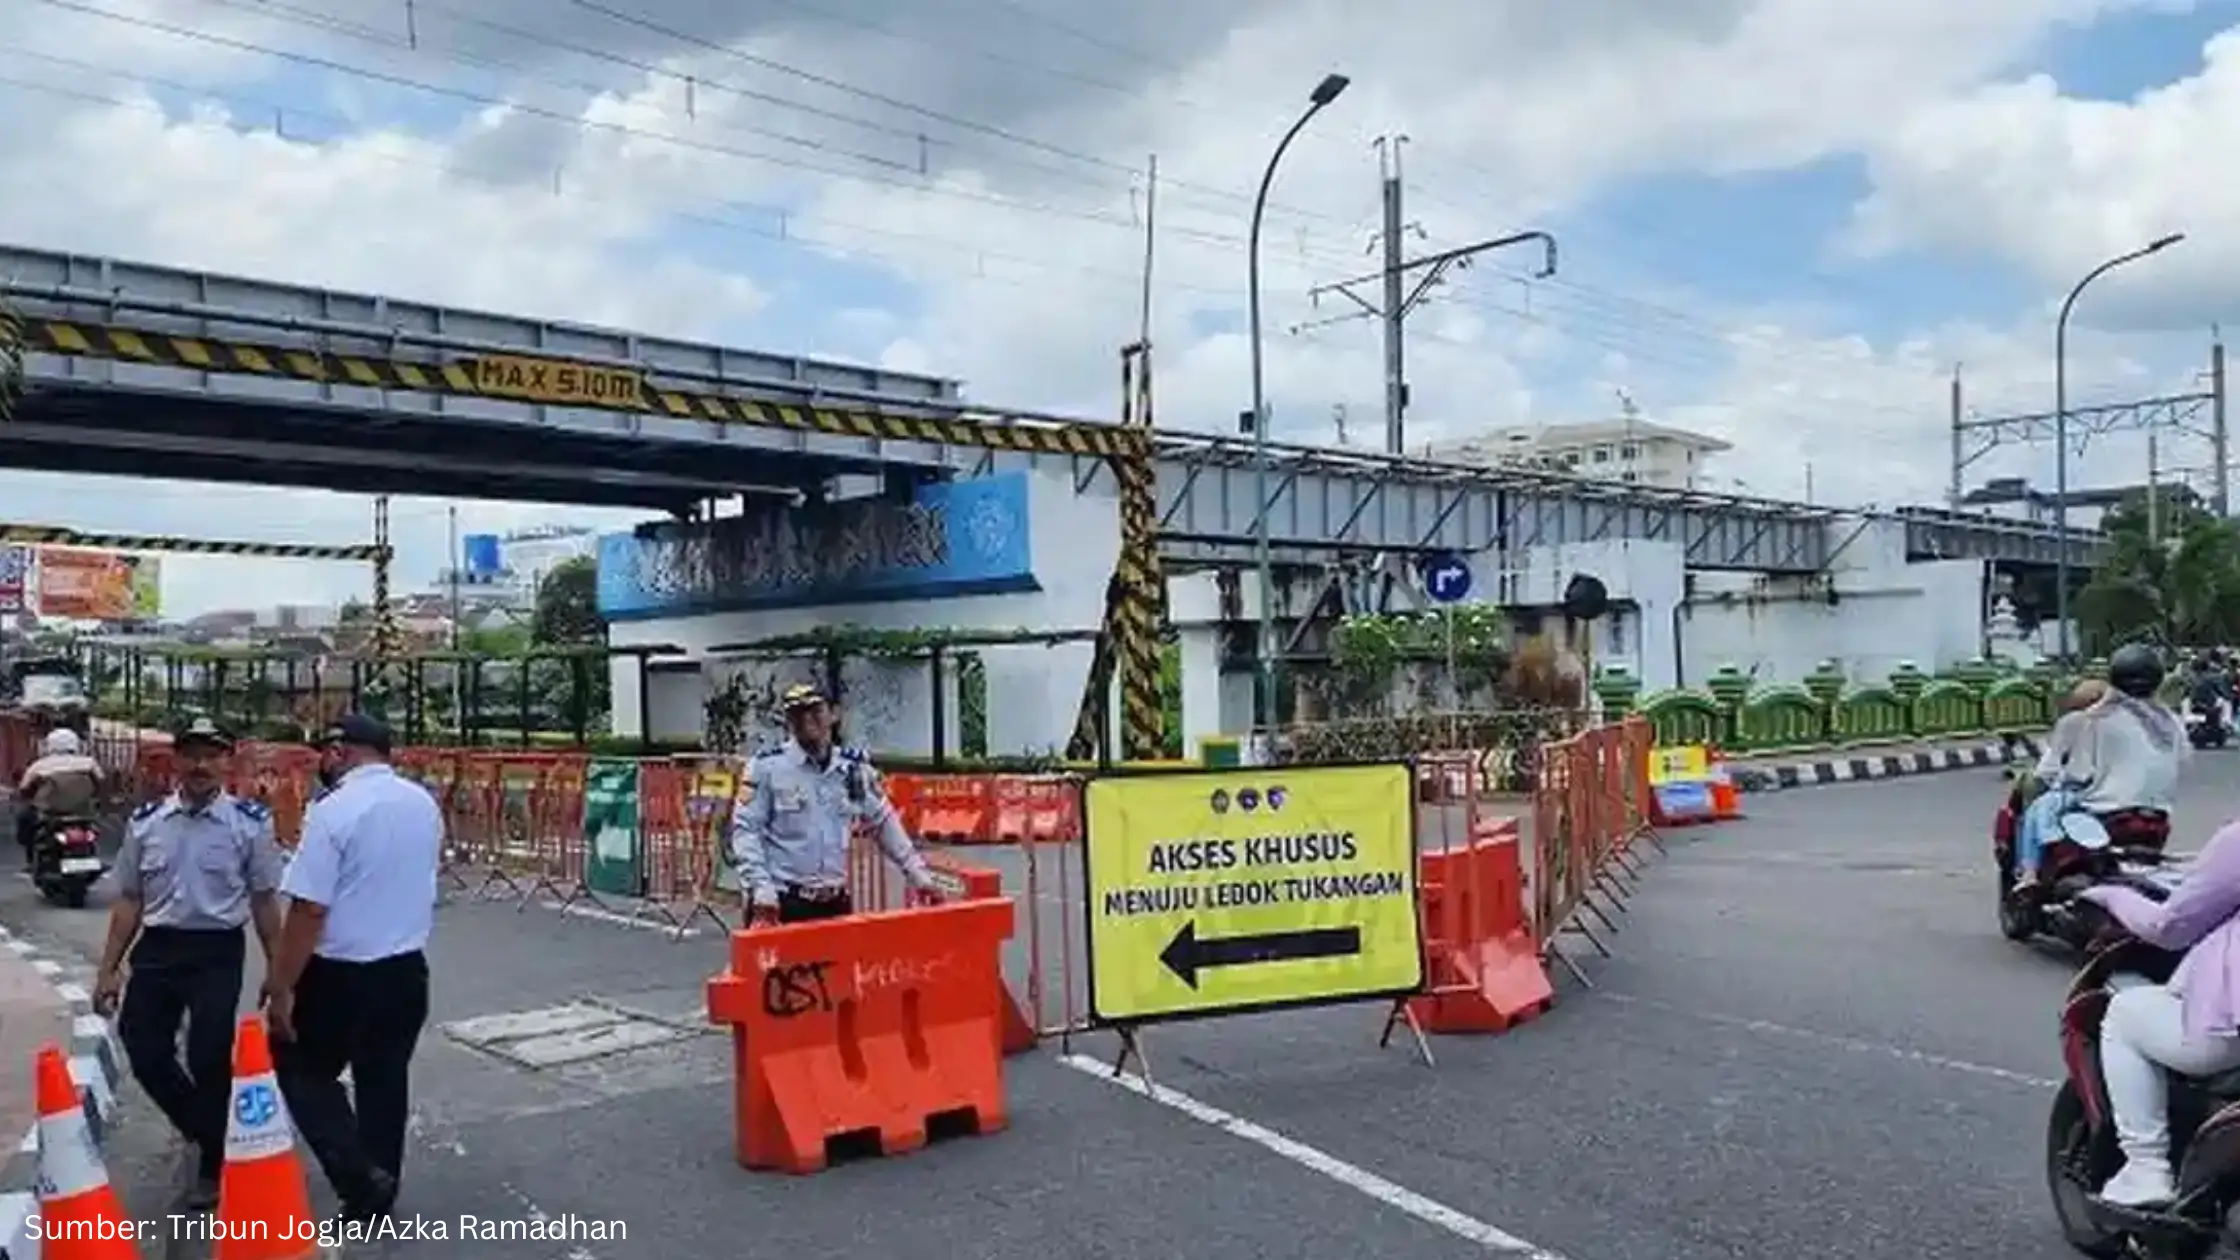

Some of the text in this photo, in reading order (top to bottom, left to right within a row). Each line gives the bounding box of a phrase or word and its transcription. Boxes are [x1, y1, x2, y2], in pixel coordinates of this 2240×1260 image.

[482, 359, 550, 392] MAX
[1149, 831, 1358, 874] AKSES KHUSUS
[1104, 871, 1404, 916] MENUJU LEDOK TUKANGAN
